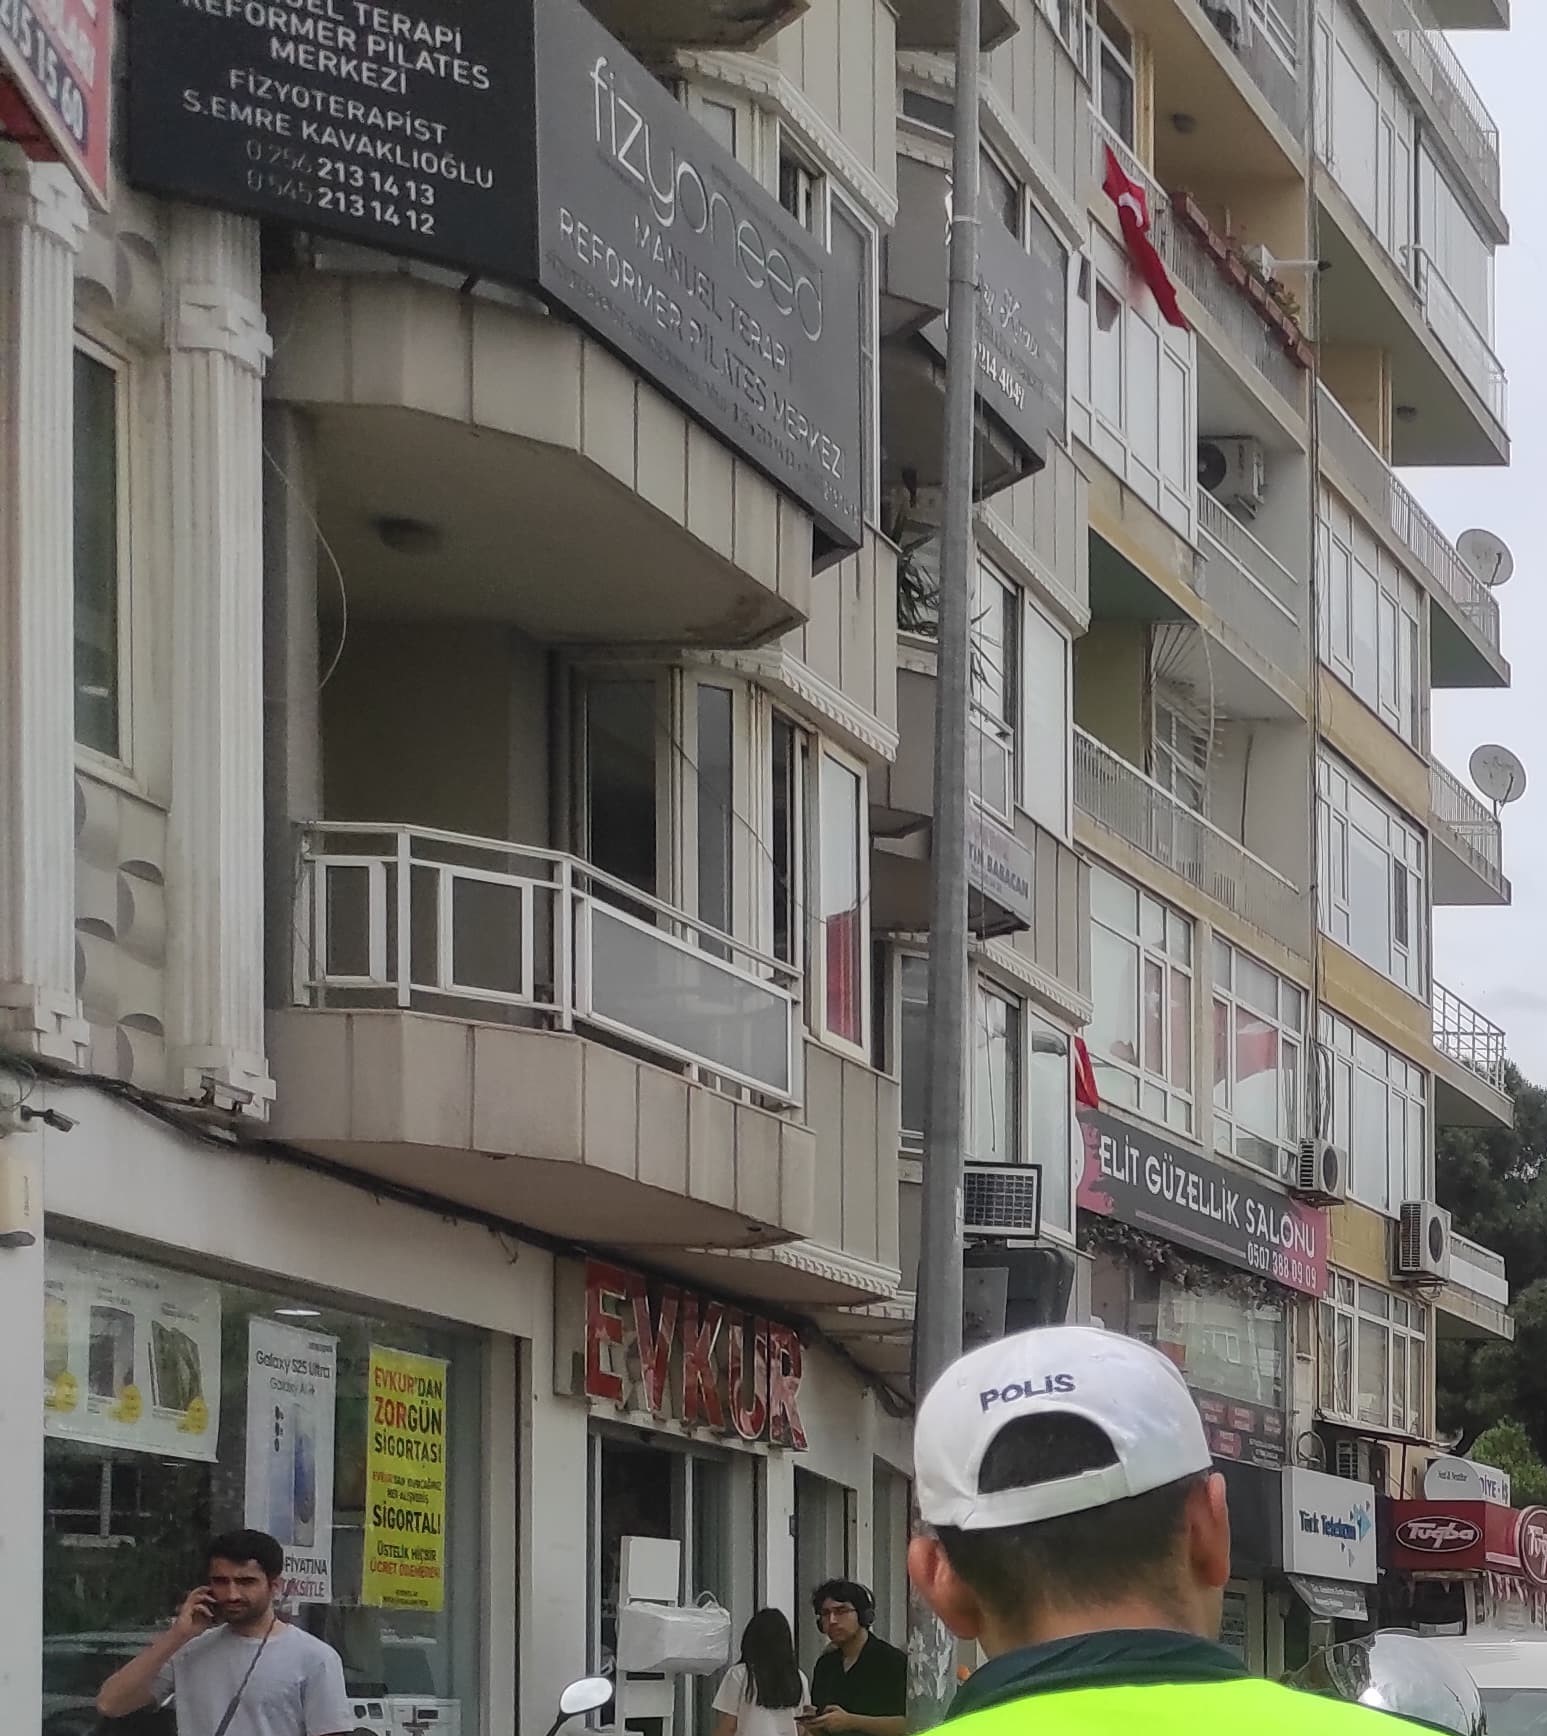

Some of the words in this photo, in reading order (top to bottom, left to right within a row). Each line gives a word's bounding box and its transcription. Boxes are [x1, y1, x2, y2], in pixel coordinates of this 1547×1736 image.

[354, 2, 462, 54] TERAPİ
[271, 36, 407, 94] MERKEZİ
[367, 35, 490, 90] PİLATES
[229, 67, 447, 145] FİZYOTERAPİST
[182, 88, 291, 136] S.EMRE
[302, 119, 494, 189] KAVAKLIOĞLU
[317, 156, 364, 187] 213
[370, 171, 400, 197] 14
[406, 180, 434, 205] 13
[317, 187, 364, 217] 213
[370, 200, 400, 226] 14
[406, 209, 434, 235] 12
[1099, 1135, 1141, 1186] ELİT
[1145, 1152, 1241, 1230] GÜZELLİK
[1245, 1198, 1316, 1259] SALONU
[256, 1350, 290, 1376] Galaxy
[584, 1257, 809, 1452] EVKUR
[374, 1366, 443, 1400] EVKUR'DAN
[373, 1501, 442, 1535] SİGORTALI
